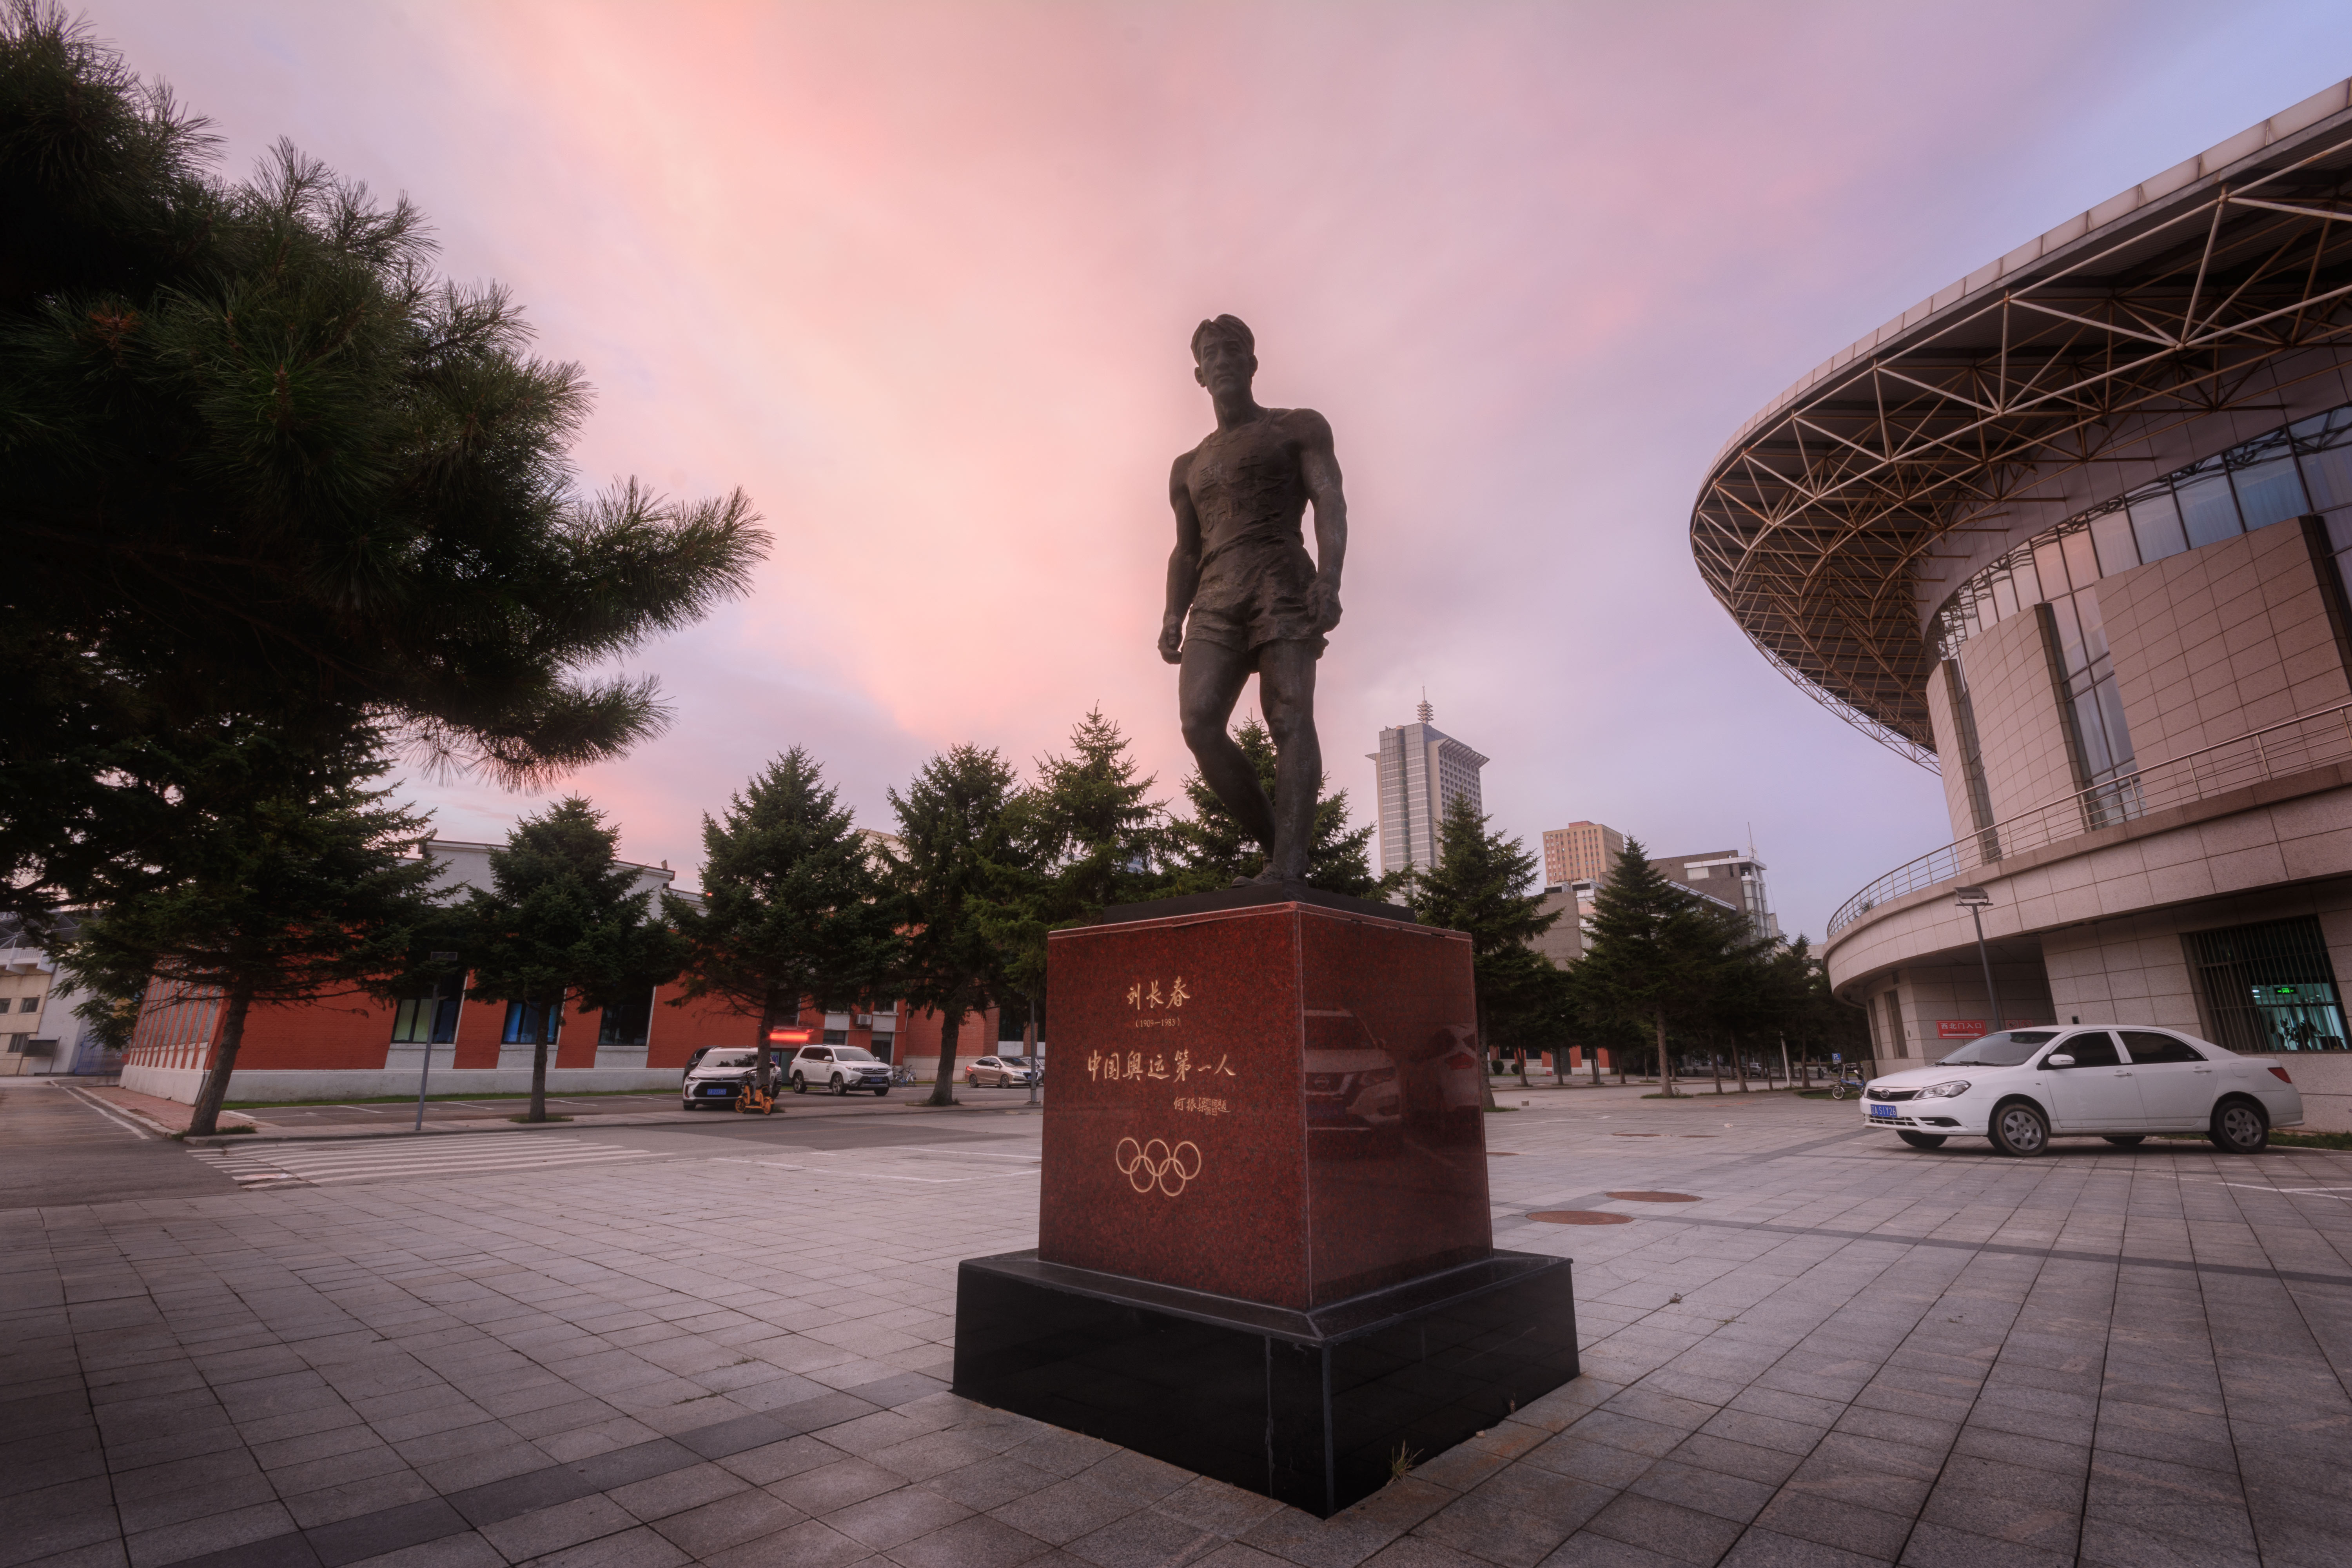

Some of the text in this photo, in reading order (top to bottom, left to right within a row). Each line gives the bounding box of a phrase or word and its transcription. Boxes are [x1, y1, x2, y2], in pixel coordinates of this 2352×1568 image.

[1127, 975, 1191, 1010] 刘长春
[1088, 1049, 1236, 1083] 中国奥运第一人
